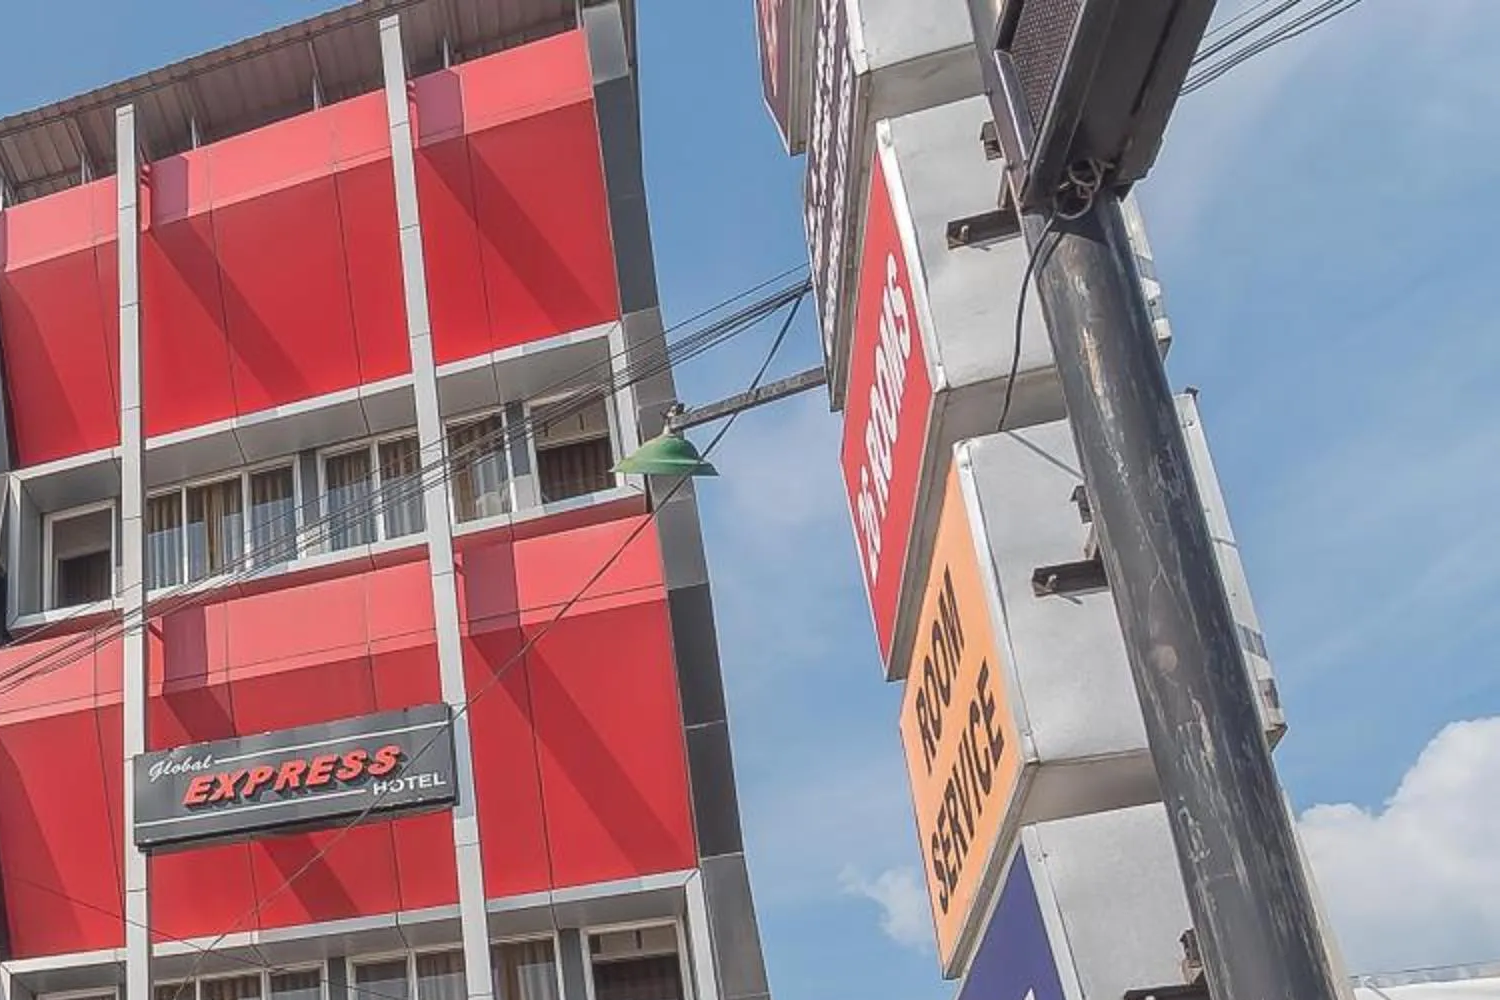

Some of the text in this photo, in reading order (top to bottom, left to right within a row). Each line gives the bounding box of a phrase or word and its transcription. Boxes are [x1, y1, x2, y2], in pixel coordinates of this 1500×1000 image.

[866, 253, 911, 520] ROOMS
[916, 563, 965, 777] ROOM
[150, 754, 212, 783] Global
[182, 744, 401, 806] EXPRESS
[372, 772, 447, 797] HOTEL
[931, 656, 1005, 915] SERVICE
